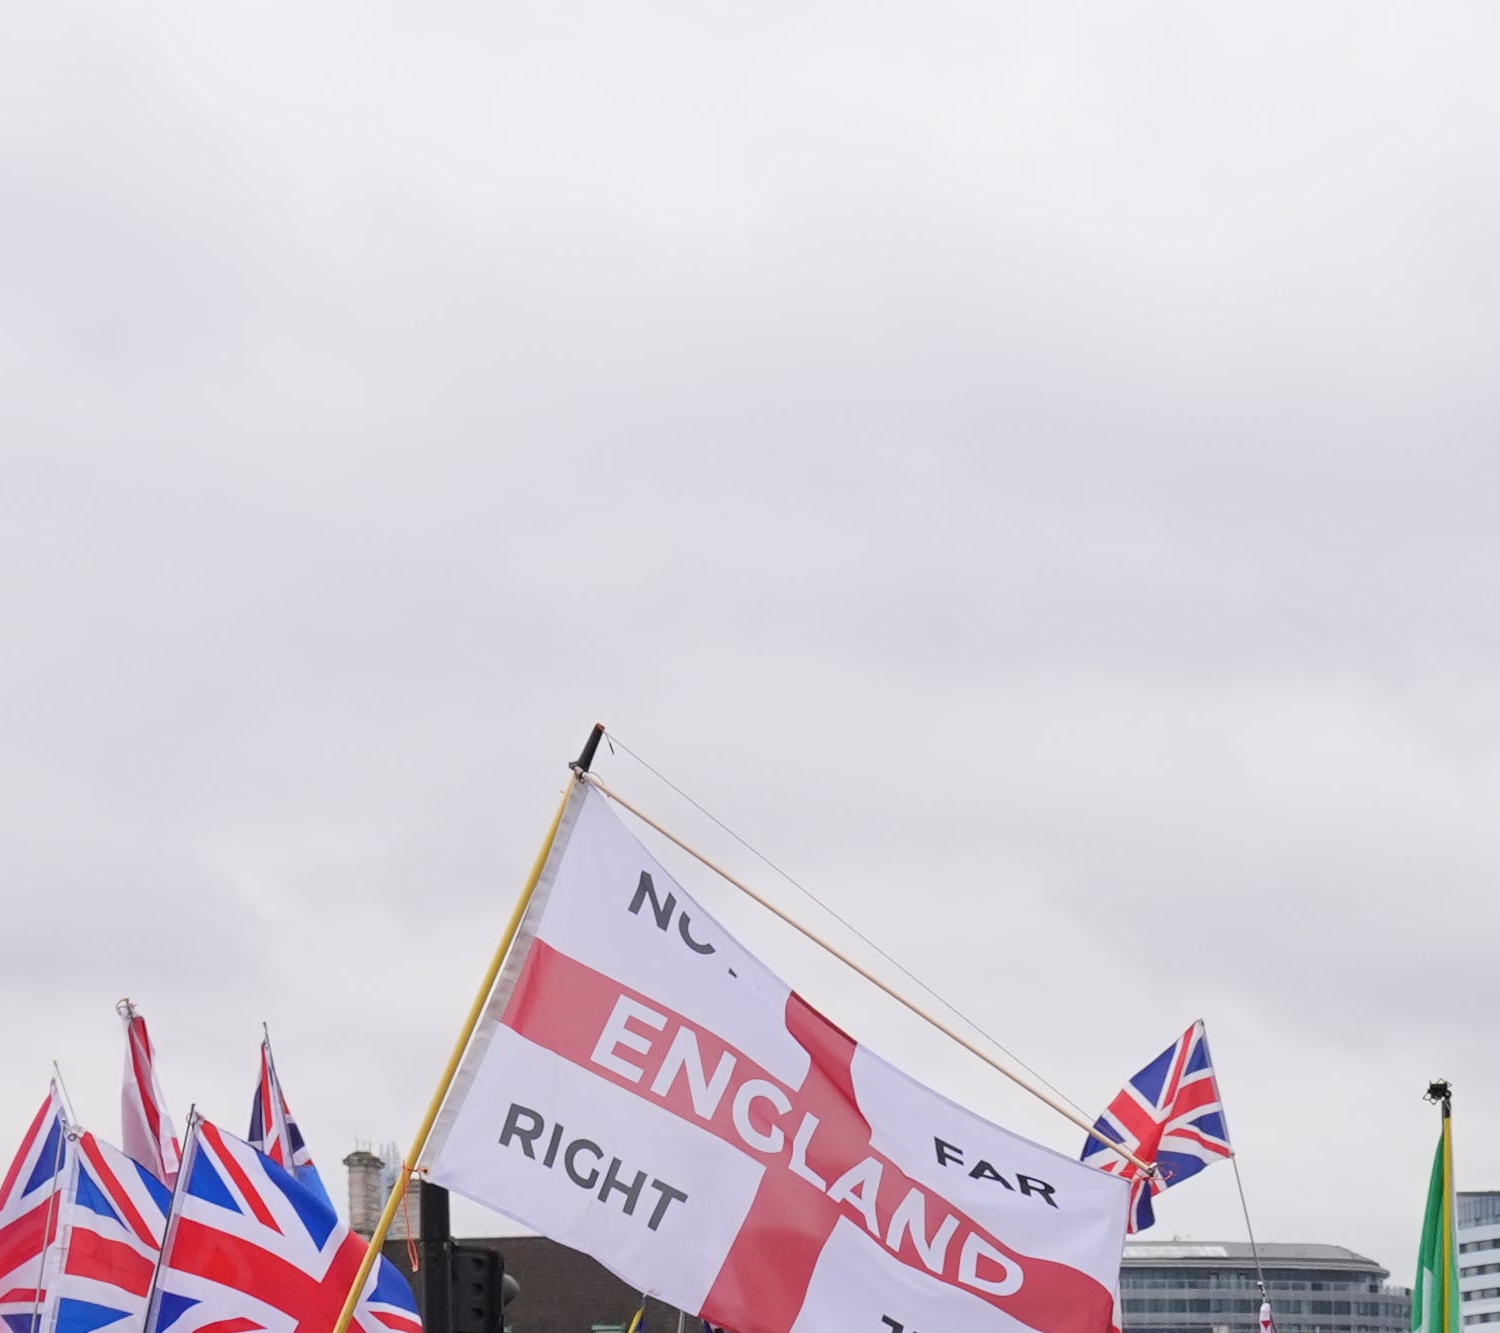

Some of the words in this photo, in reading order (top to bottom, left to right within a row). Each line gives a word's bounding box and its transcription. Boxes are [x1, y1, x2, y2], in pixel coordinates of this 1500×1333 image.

[497, 1102, 689, 1232] RIGHT
[590, 993, 1025, 1298] ENGLAND
[933, 1135, 1060, 1209] FAR
